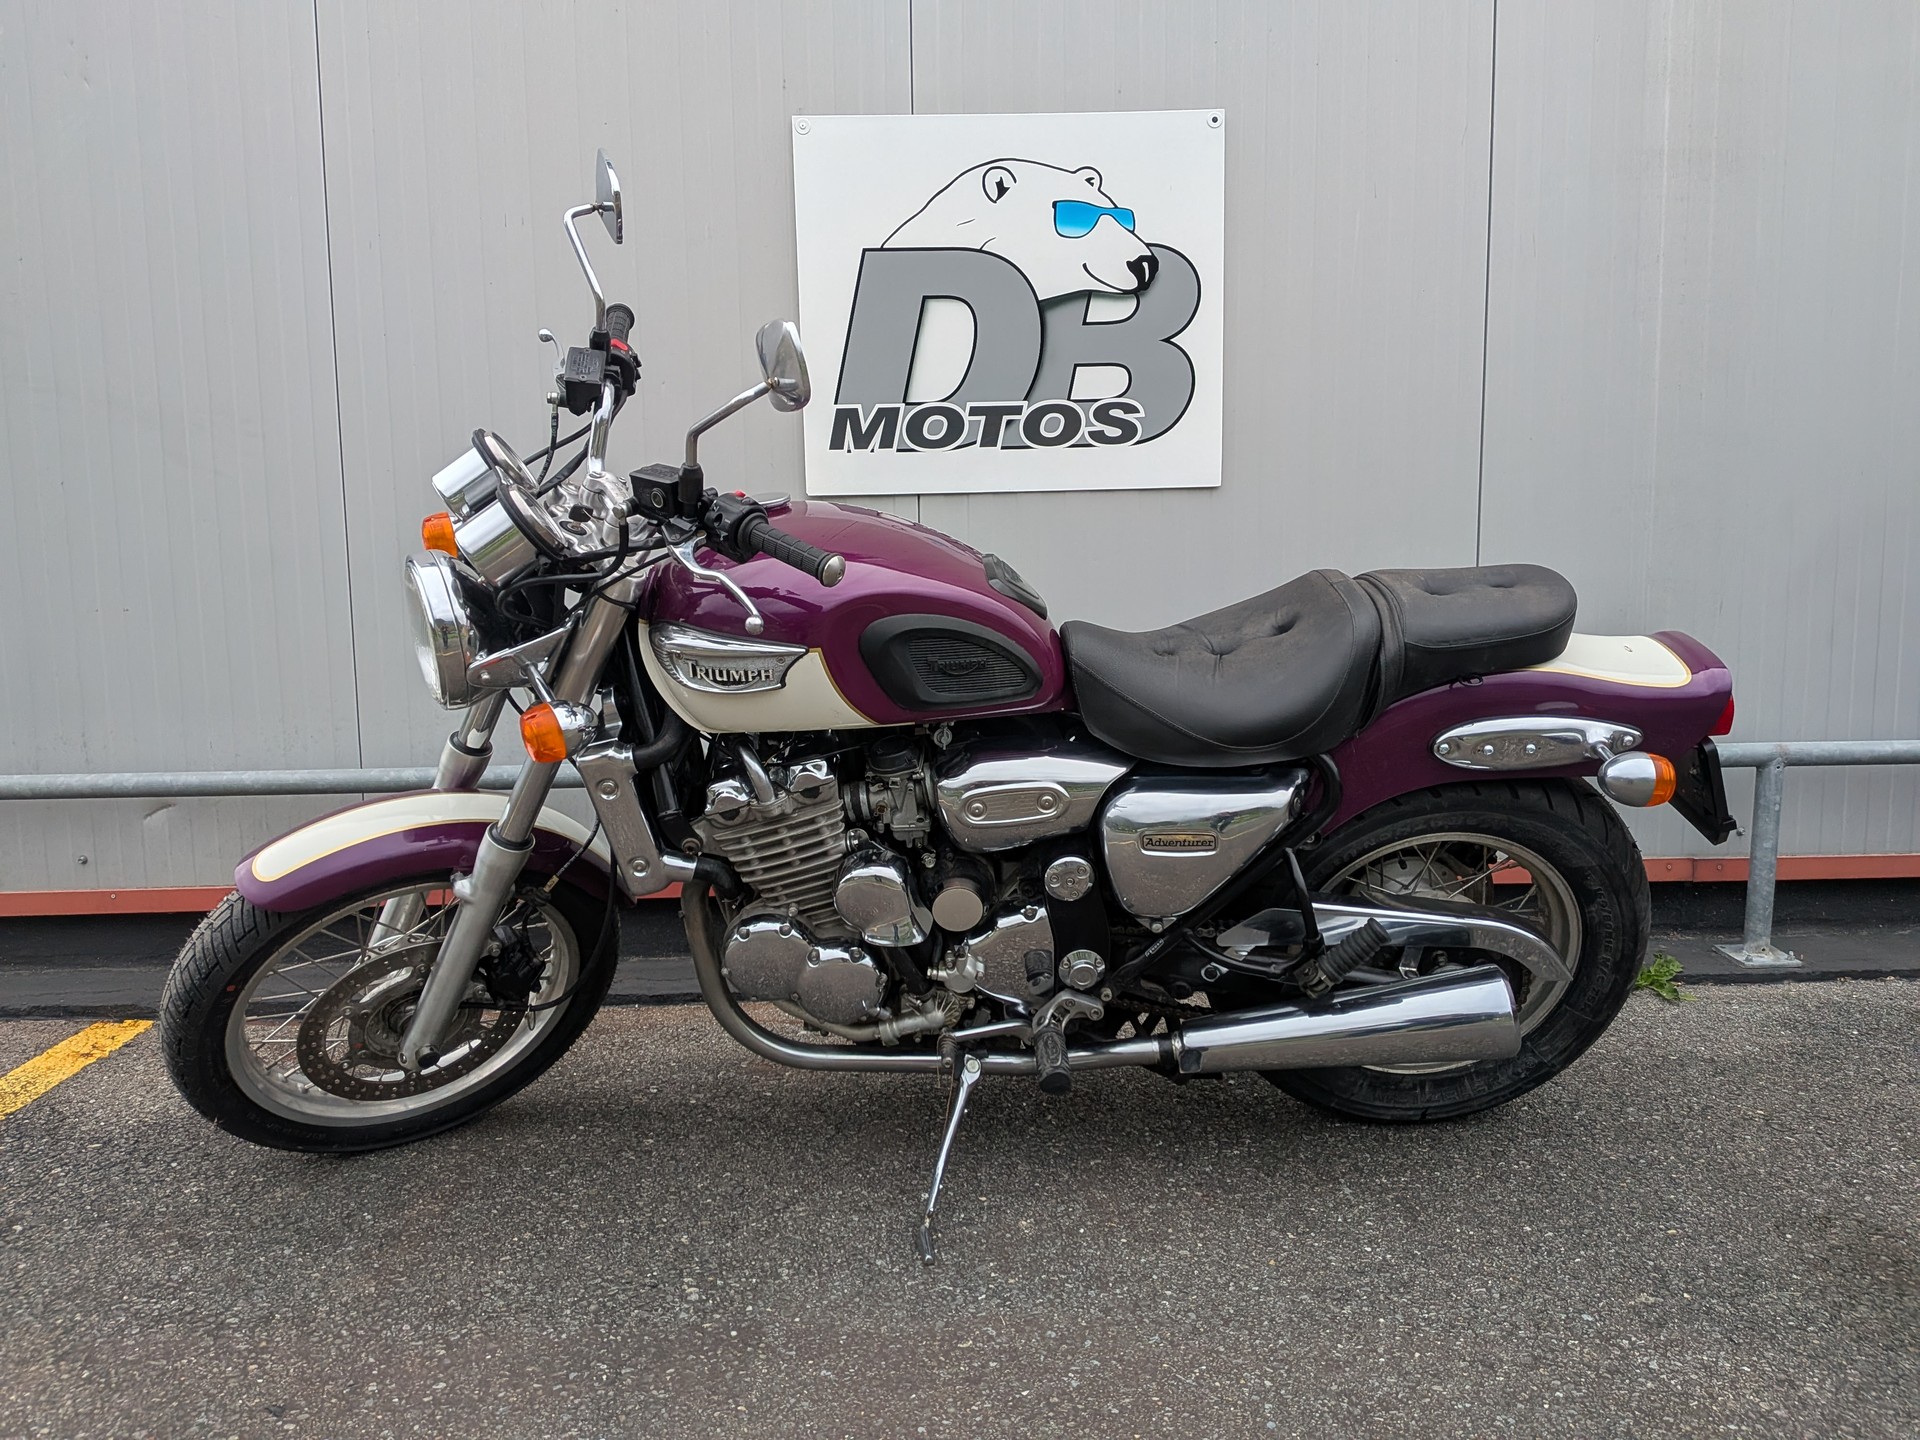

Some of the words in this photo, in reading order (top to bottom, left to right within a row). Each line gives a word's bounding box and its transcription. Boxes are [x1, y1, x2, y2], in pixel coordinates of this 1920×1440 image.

[834, 243, 1201, 452] DB
[828, 400, 1146, 452] MOTOS
[683, 657, 774, 683] TRIUMPH
[1145, 837, 1214, 847] Adventurer
